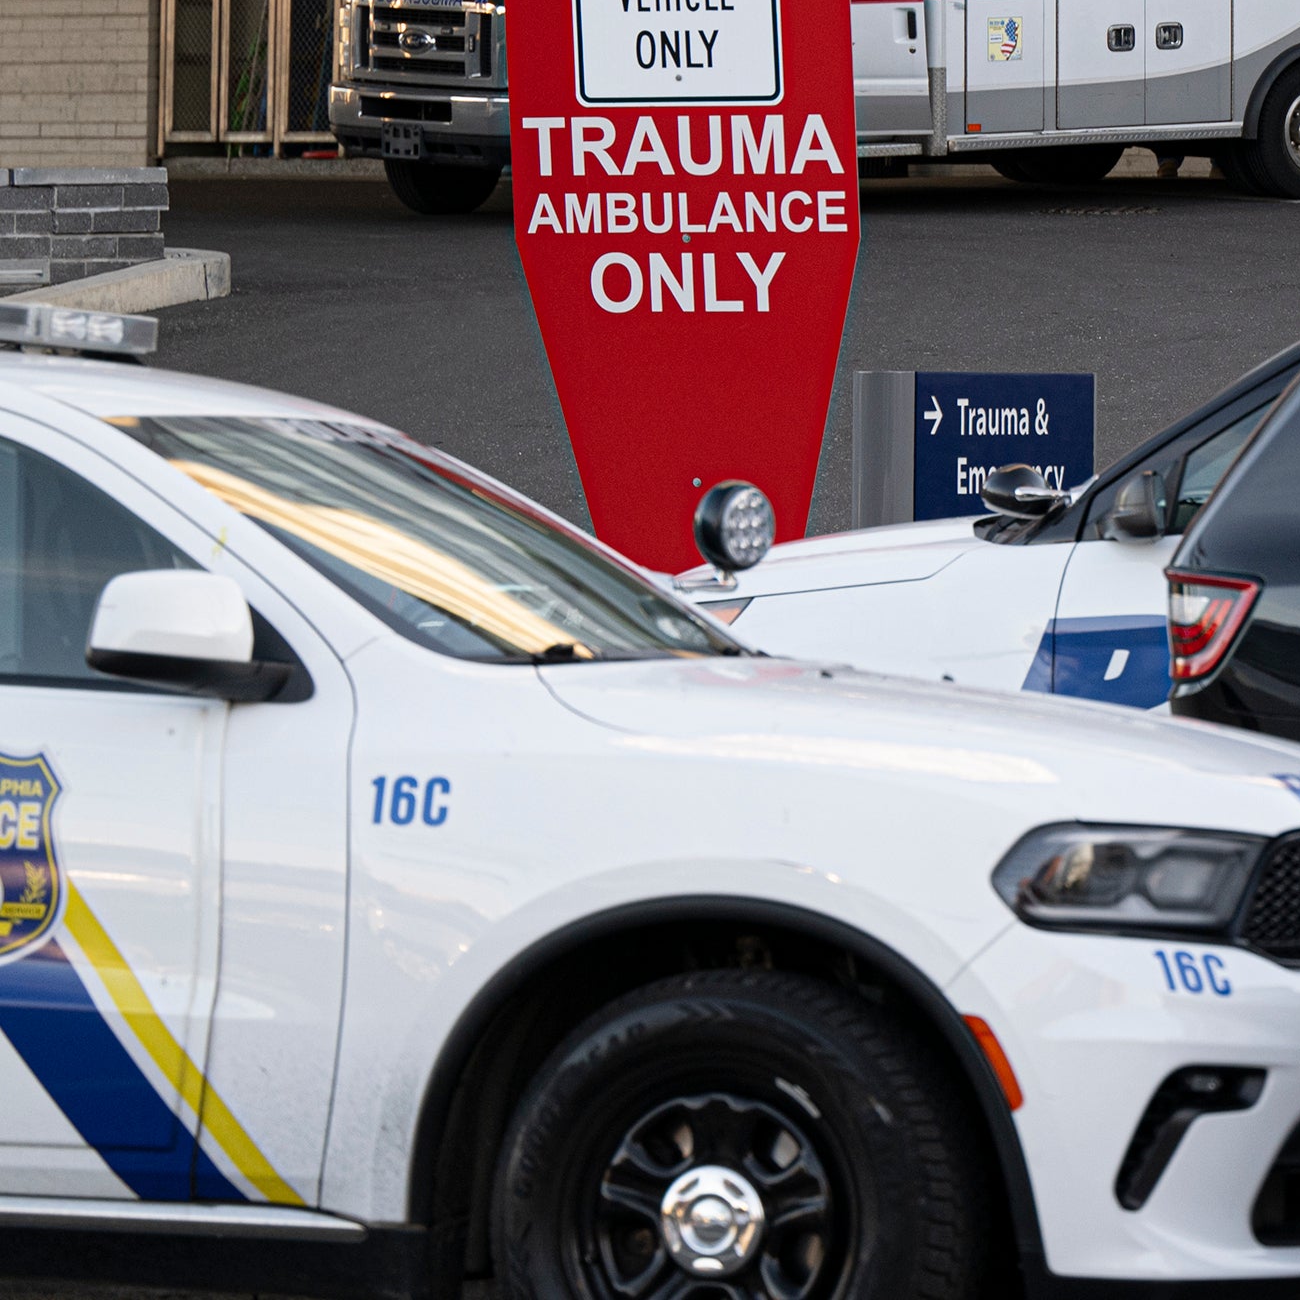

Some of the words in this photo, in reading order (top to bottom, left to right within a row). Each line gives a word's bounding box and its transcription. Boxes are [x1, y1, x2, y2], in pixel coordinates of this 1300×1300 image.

[636, 29, 719, 69] ONLY
[522, 113, 844, 177] TRAUMA
[528, 190, 848, 234] AMBULANCE
[590, 251, 786, 313] ONLY
[956, 398, 1029, 436] Trauma
[1034, 398, 1049, 436] &
[371, 775, 451, 827] 16C
[1153, 948, 1233, 998] 16C
